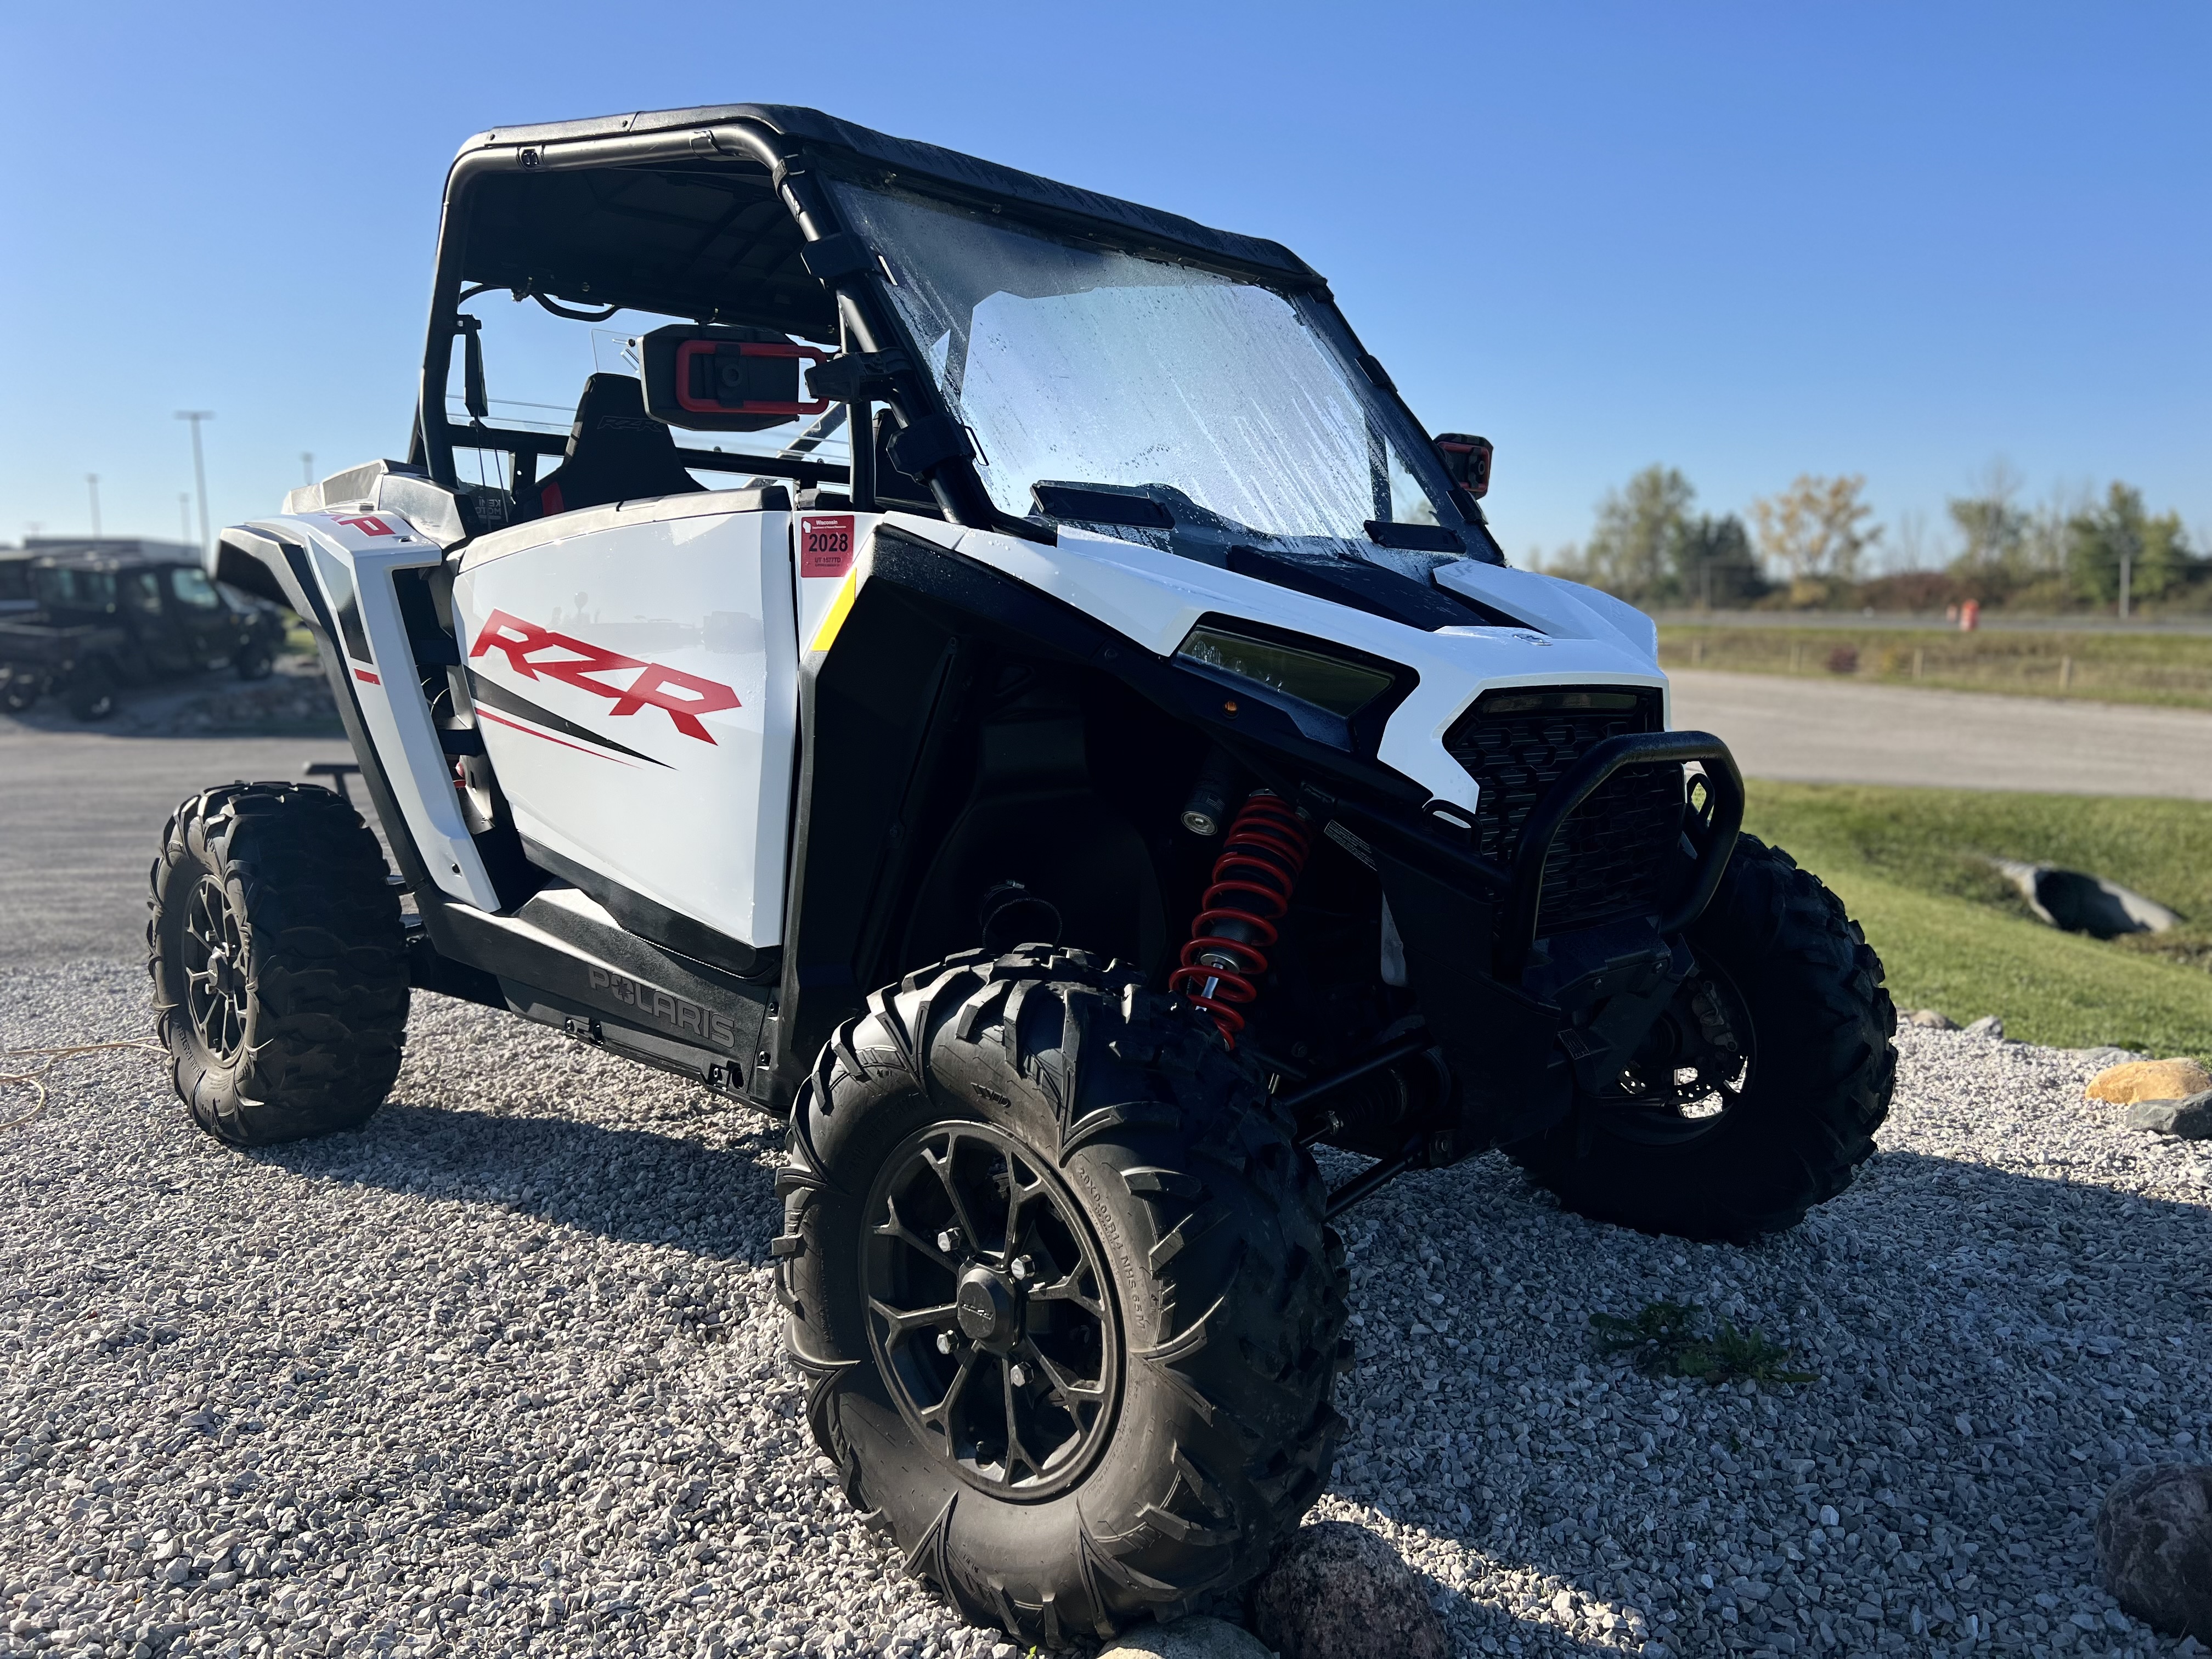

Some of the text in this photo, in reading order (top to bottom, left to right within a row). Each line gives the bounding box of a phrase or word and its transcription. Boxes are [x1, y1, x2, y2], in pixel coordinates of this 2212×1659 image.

[809, 534, 848, 552] 2028
[469, 607, 742, 746] RZR
[589, 965, 736, 1048] POLARIS
